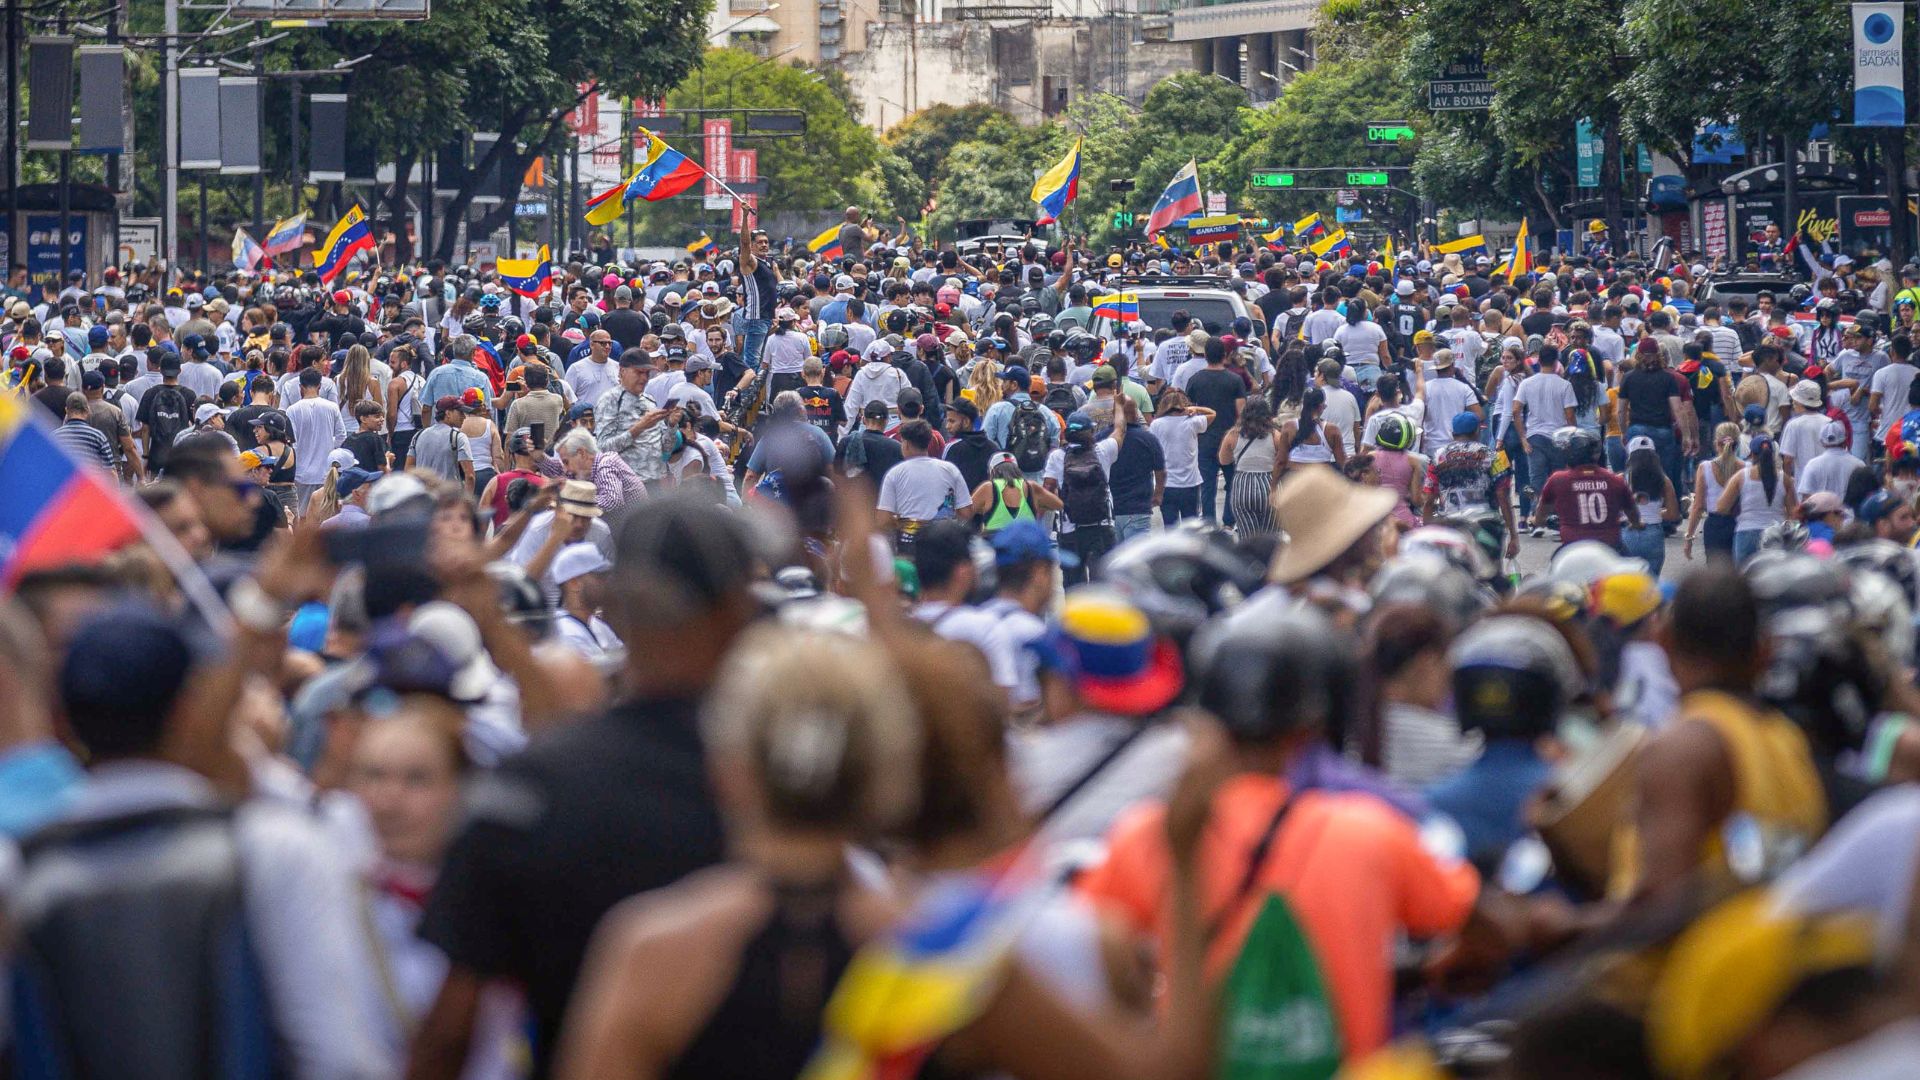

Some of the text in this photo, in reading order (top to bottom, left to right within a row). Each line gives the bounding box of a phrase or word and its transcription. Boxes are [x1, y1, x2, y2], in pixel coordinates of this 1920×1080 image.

[1859, 56, 1900, 67] BADAN
[1433, 84, 1457, 94] URB.
[1434, 97, 1451, 107] AV.
[1367, 127, 1385, 141] 04
[1113, 212, 1133, 229] 24
[1573, 480, 1608, 491] SOTELDO
[1578, 492, 1608, 524] 10
